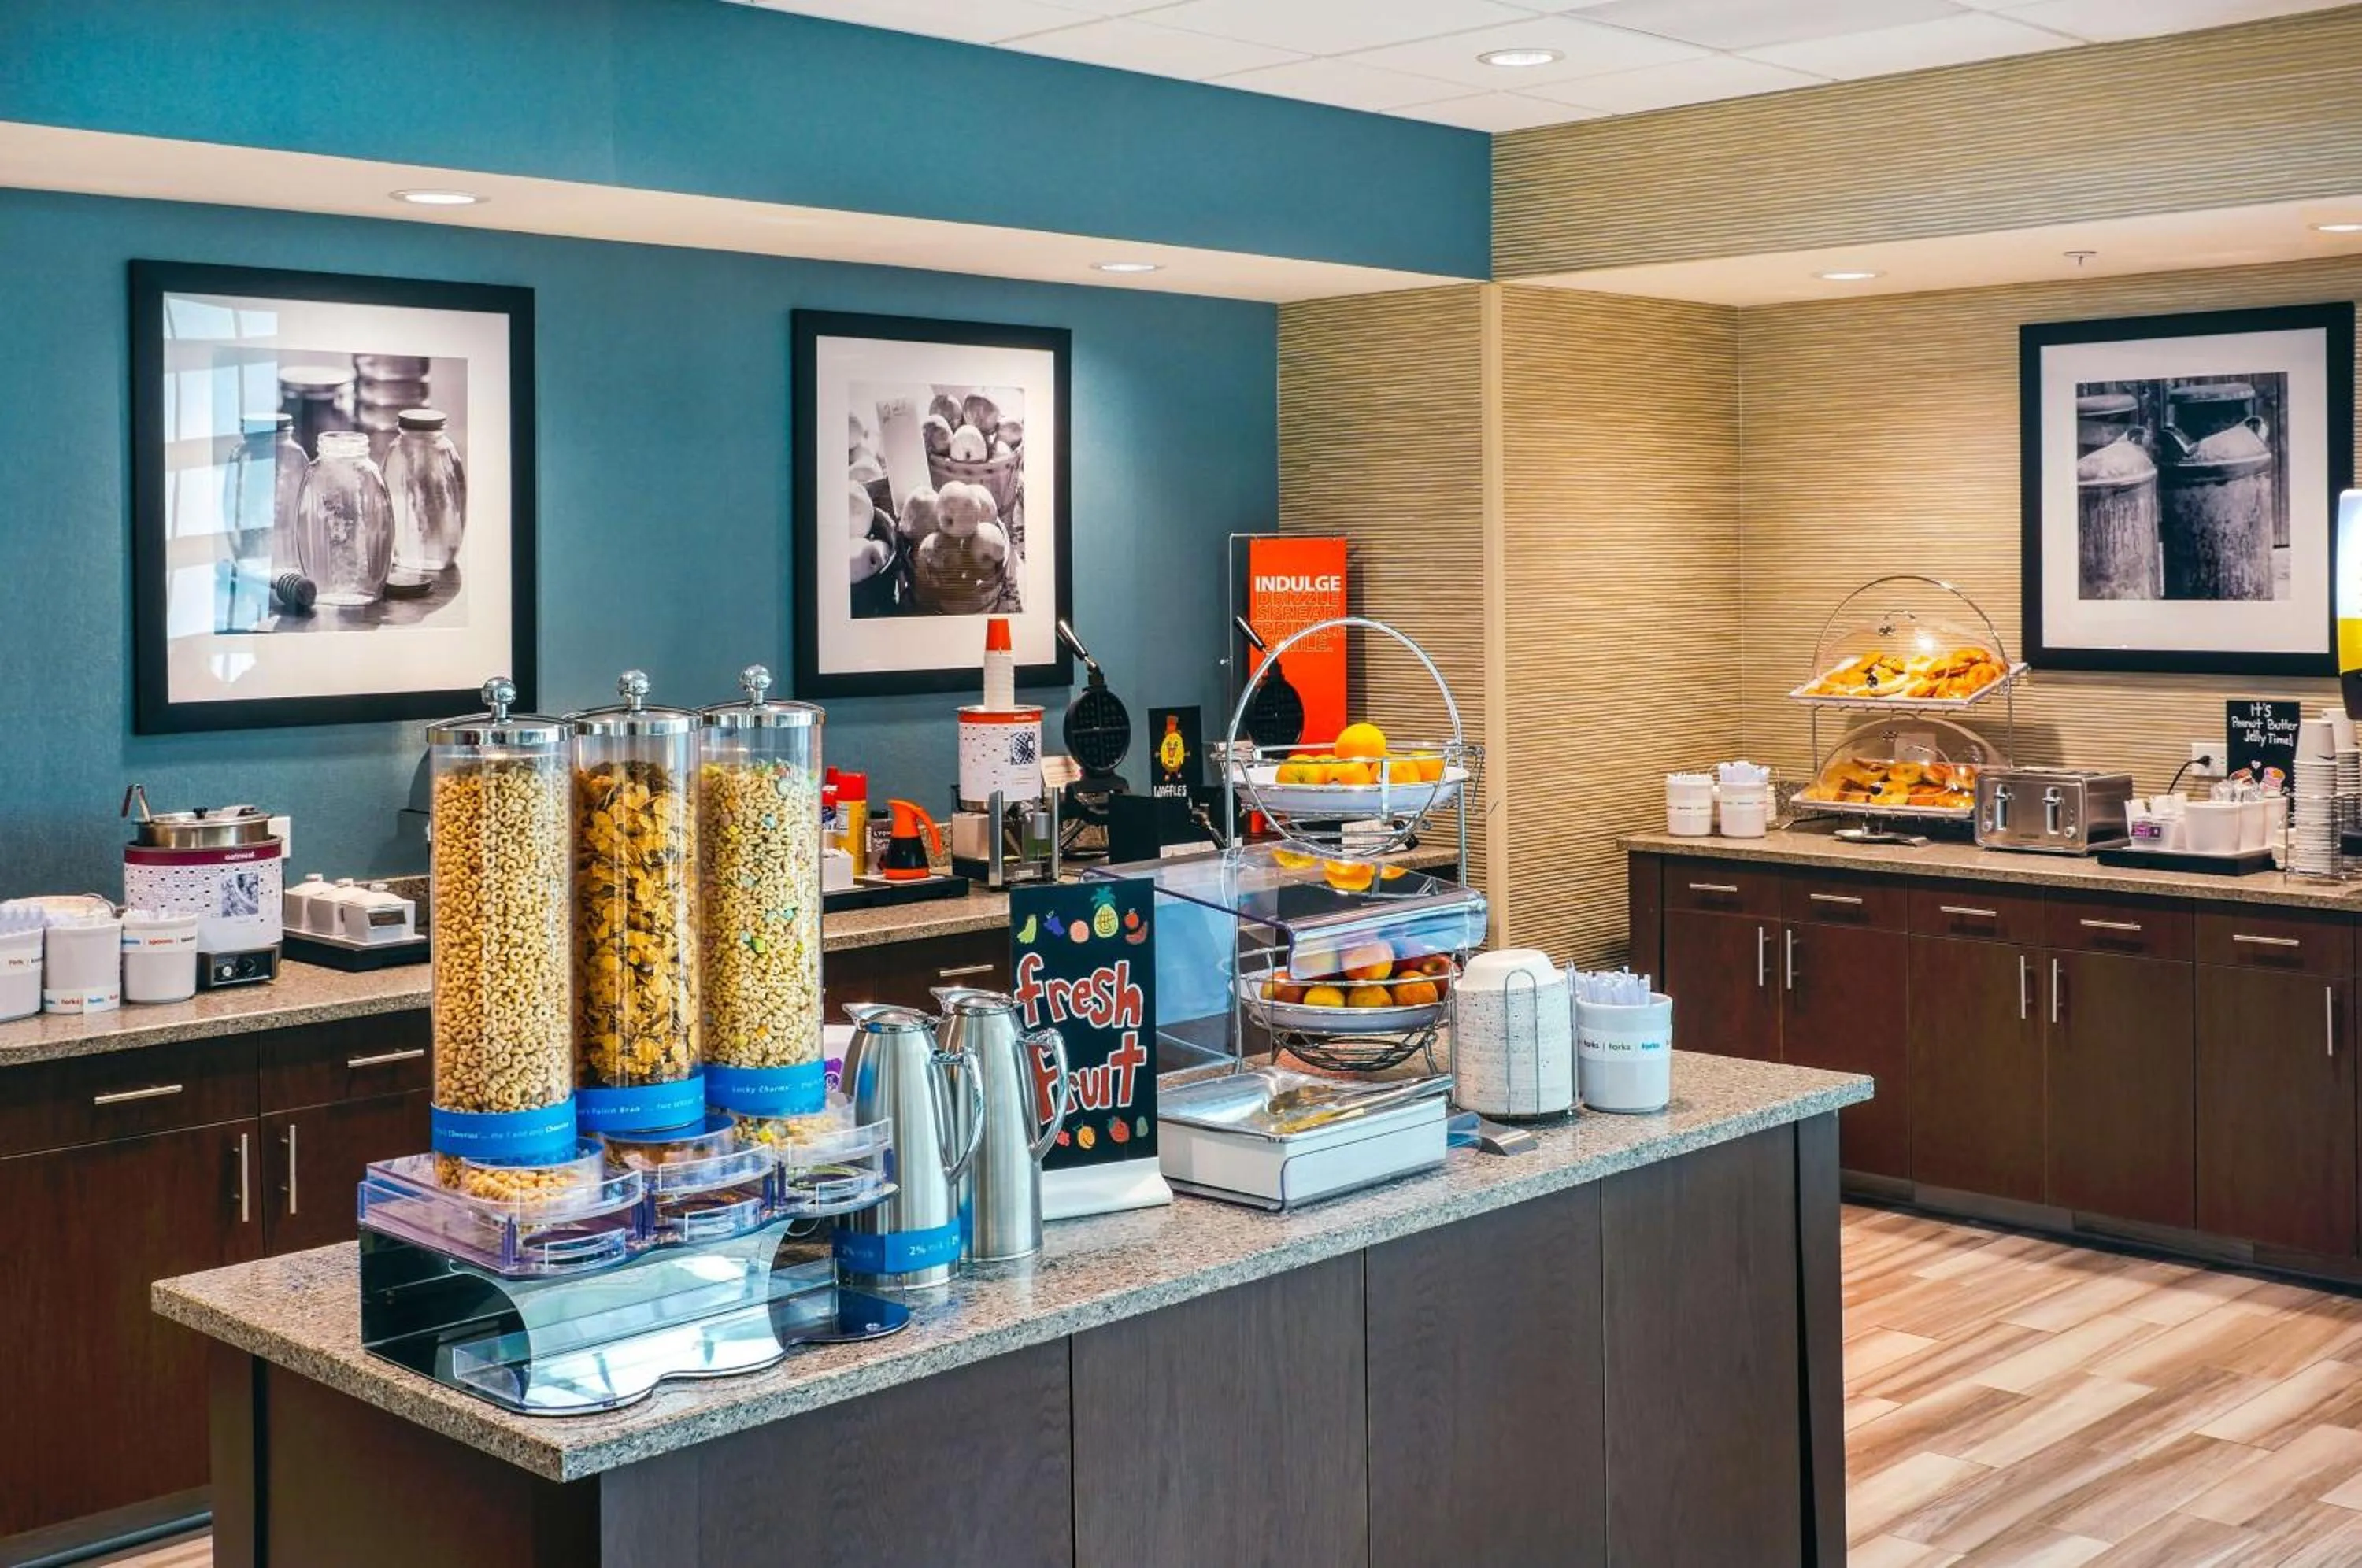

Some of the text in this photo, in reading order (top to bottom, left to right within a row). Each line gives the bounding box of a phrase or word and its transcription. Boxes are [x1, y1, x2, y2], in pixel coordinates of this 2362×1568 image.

[1255, 575, 1342, 592] INDULGE
[1257, 592, 1340, 605] DRIZZLE
[1257, 605, 1341, 620] SPREAD
[2267, 719, 2298, 730] Butter
[1014, 952, 1144, 1028] fresh
[1609, 1042, 1631, 1051] forks
[909, 1245, 927, 1256] 2%
